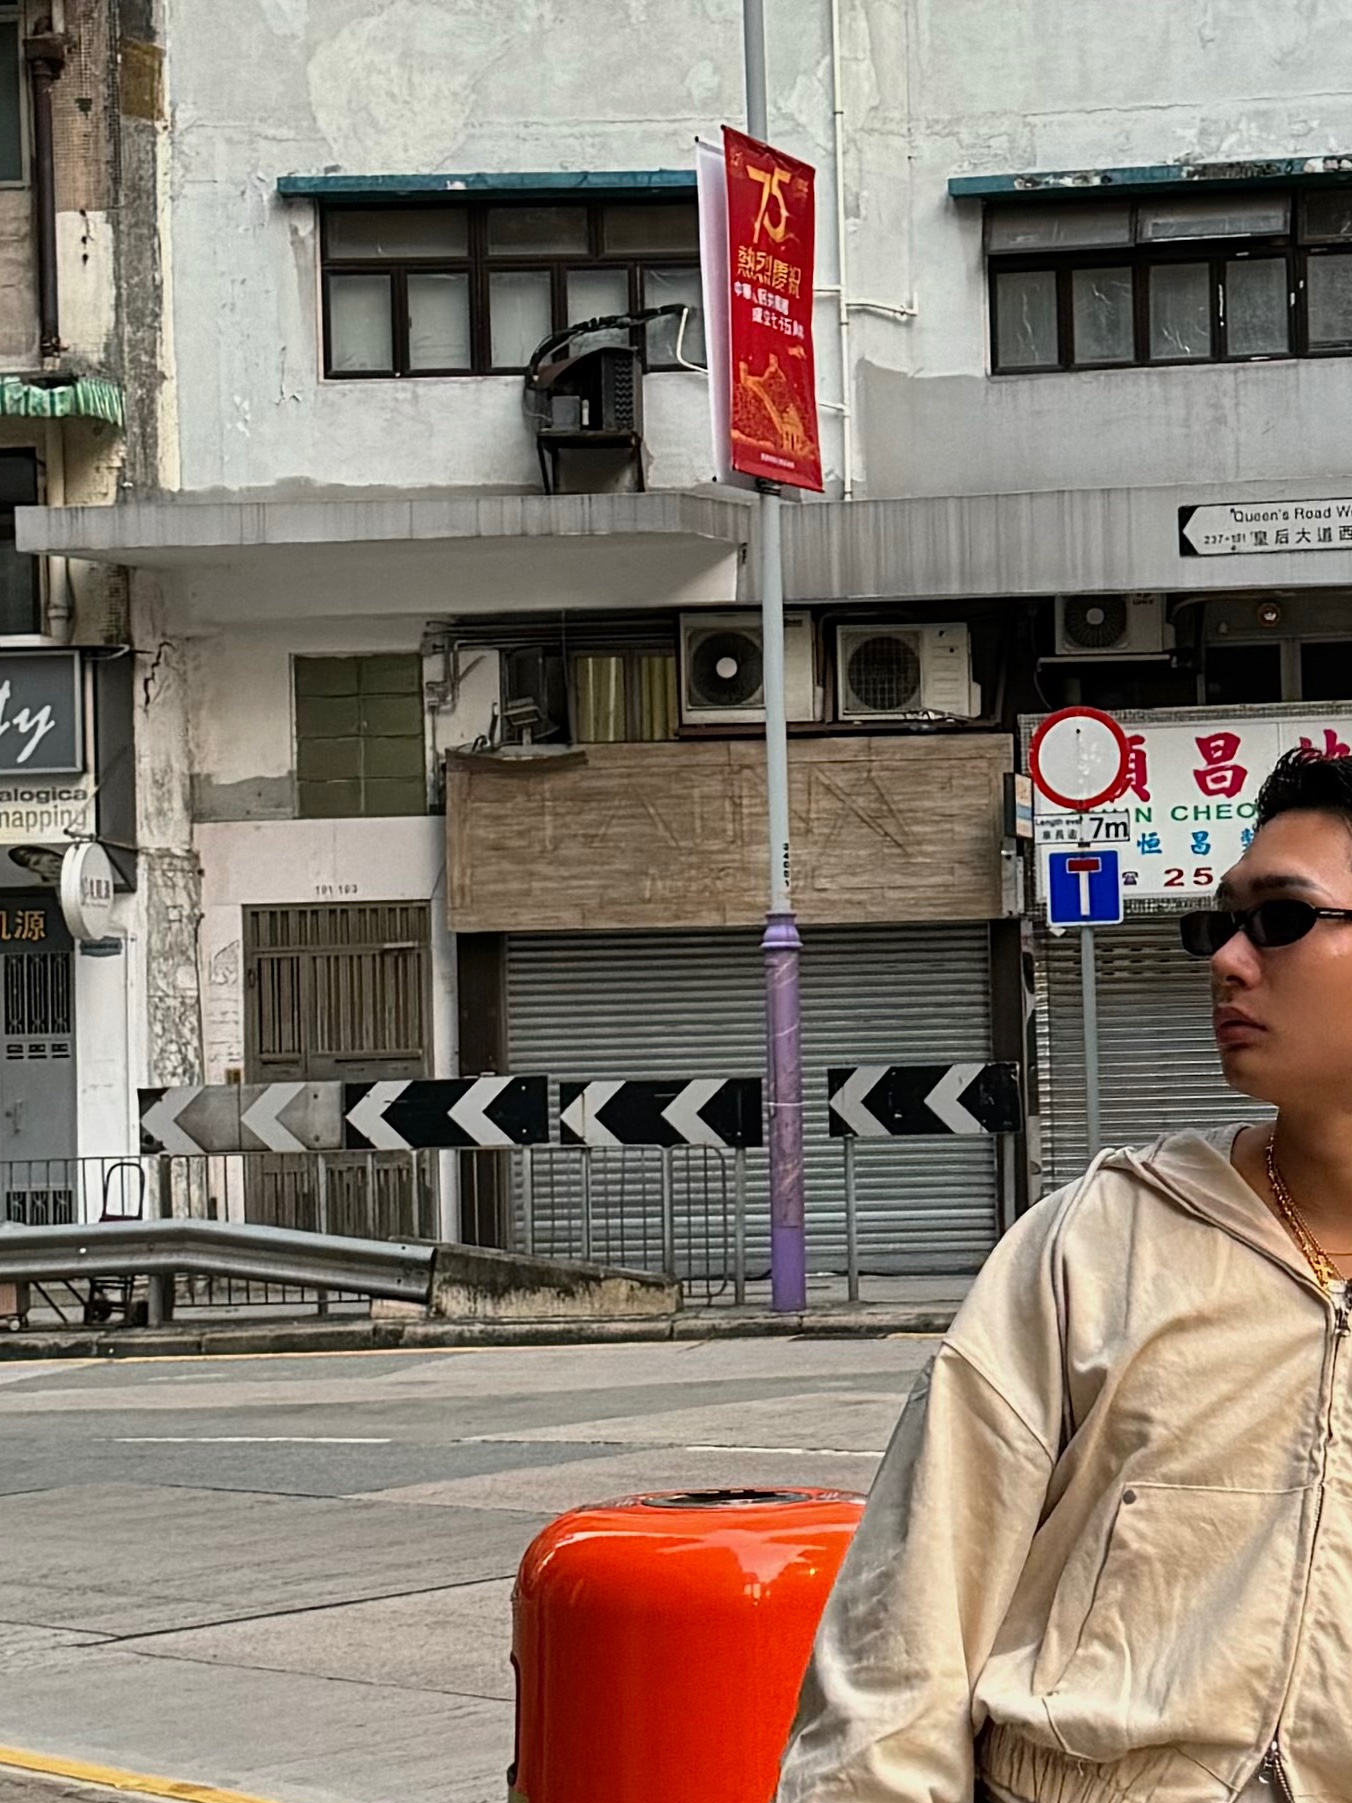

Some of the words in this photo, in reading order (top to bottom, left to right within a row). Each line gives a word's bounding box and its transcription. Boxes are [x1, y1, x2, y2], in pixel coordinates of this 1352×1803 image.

[746, 164, 792, 244] 75
[1233, 509, 1290, 523] Queen's
[1294, 507, 1332, 520] Road
[1170, 802, 1257, 822] CHEO
[1089, 817, 1129, 839] 7m
[1163, 867, 1214, 888] 25
